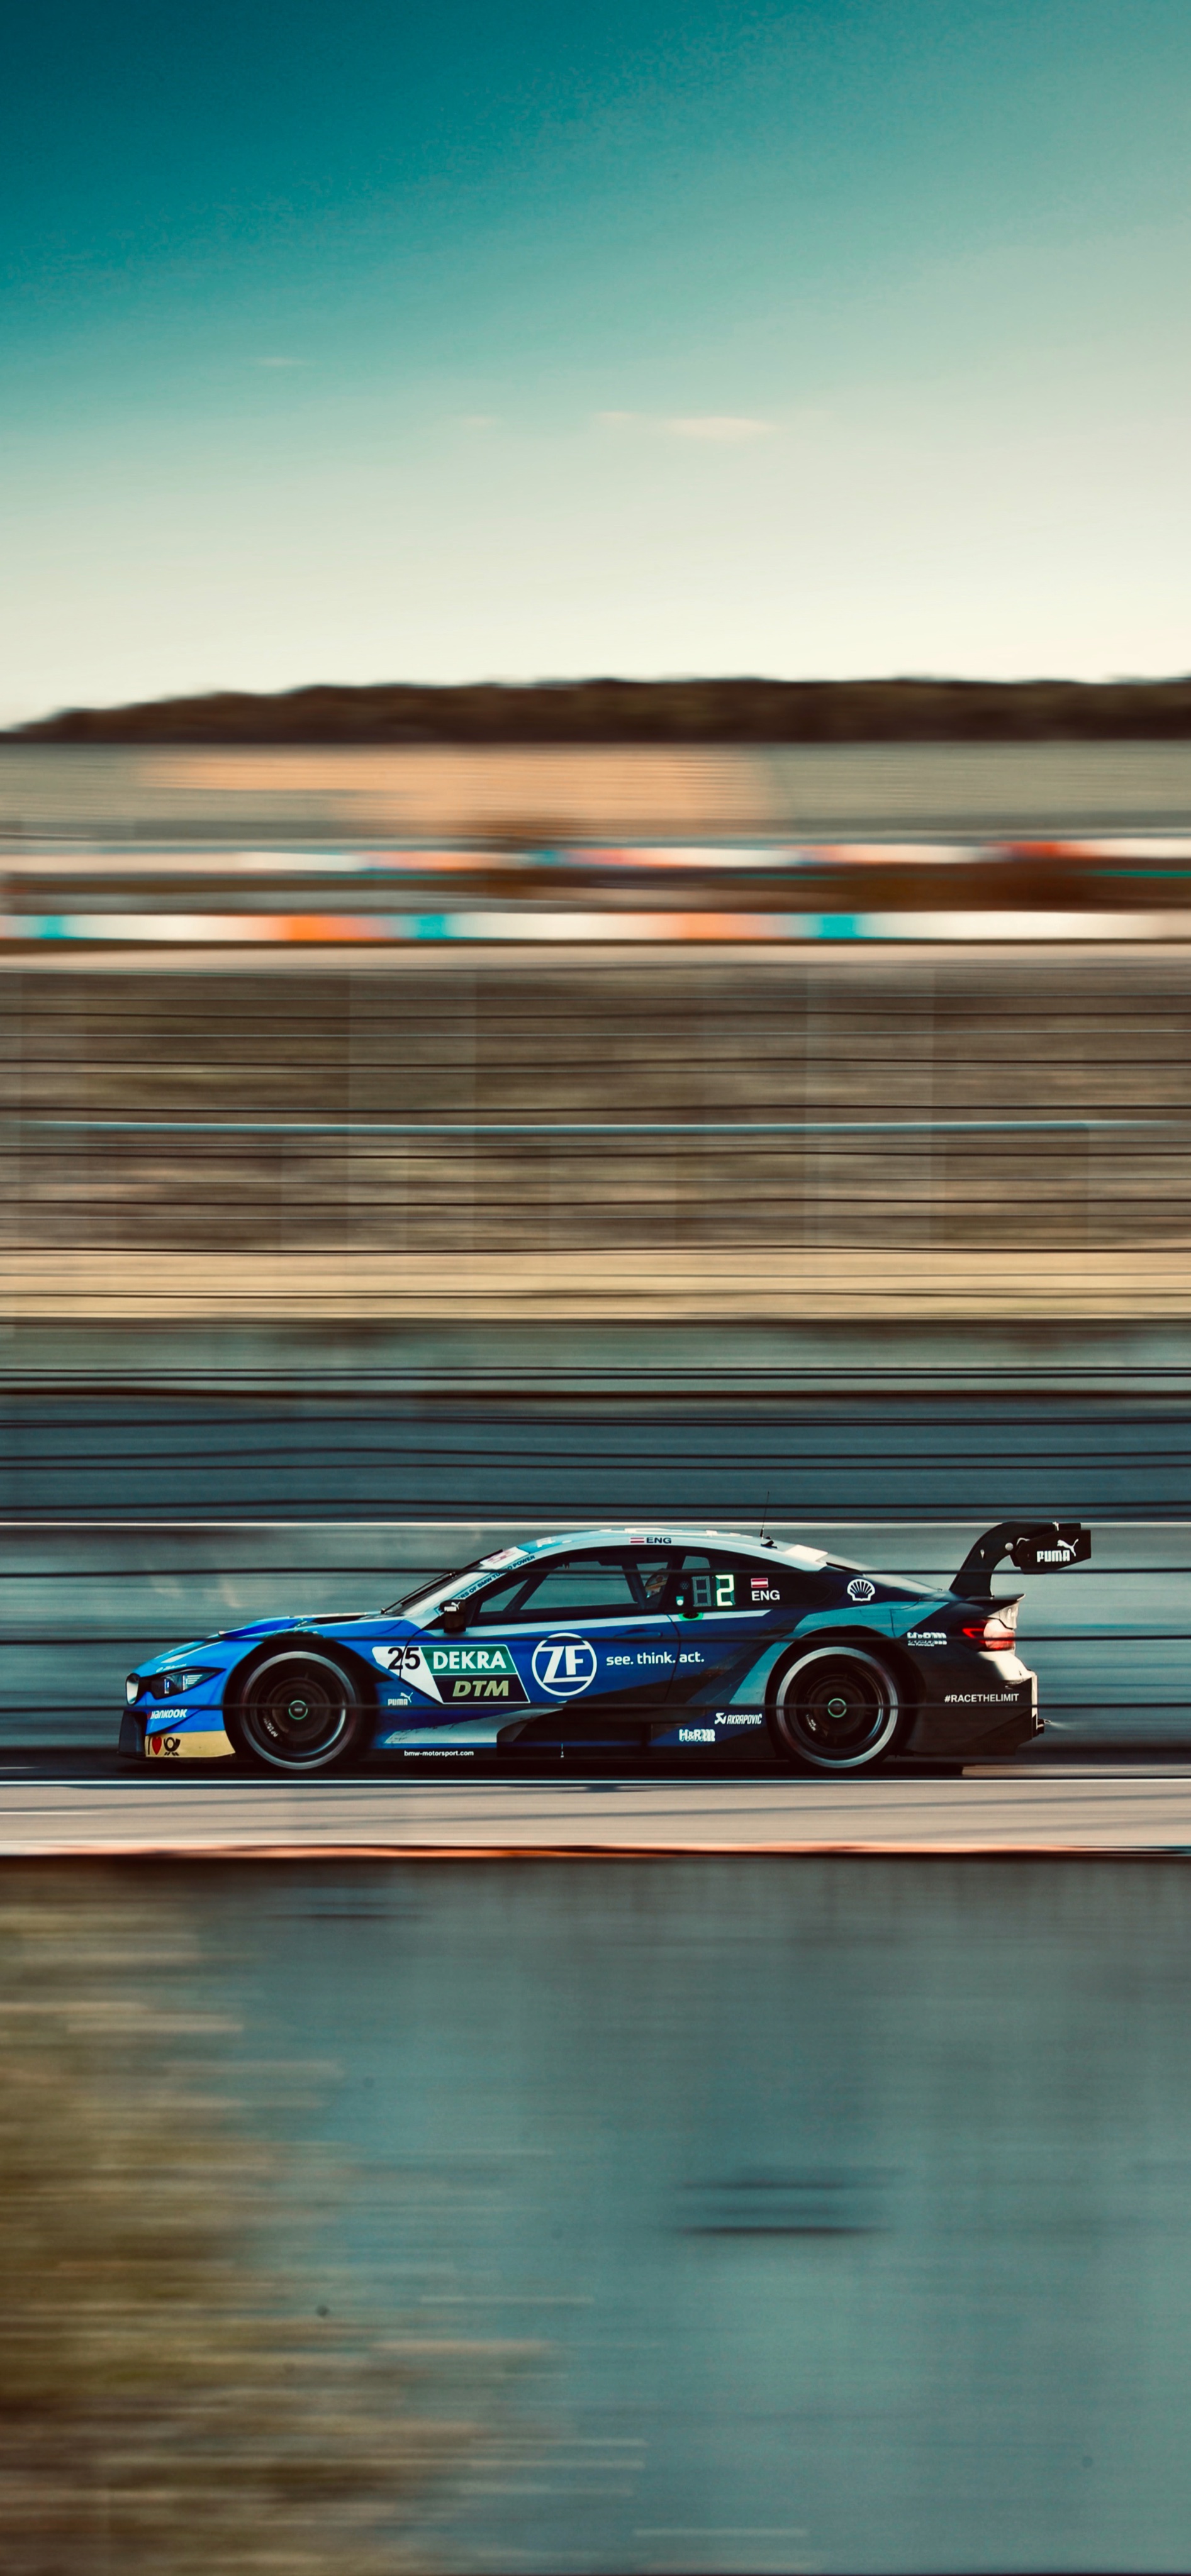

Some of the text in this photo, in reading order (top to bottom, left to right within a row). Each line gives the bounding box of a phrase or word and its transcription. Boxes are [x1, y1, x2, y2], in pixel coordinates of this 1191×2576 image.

[1037, 1550, 1070, 1562] PUMA
[477, 1577, 493, 1588] BMW
[513, 1555, 535, 1568] POWER
[751, 1590, 780, 1601] ENG
[388, 1647, 421, 1670] 25
[433, 1651, 506, 1670] DEKRA
[537, 1643, 592, 1684] ZF
[606, 1651, 705, 1666] see. think. act.
[452, 1680, 509, 1697] DTM
[944, 1694, 1019, 1703] #RACETHELIMIT
